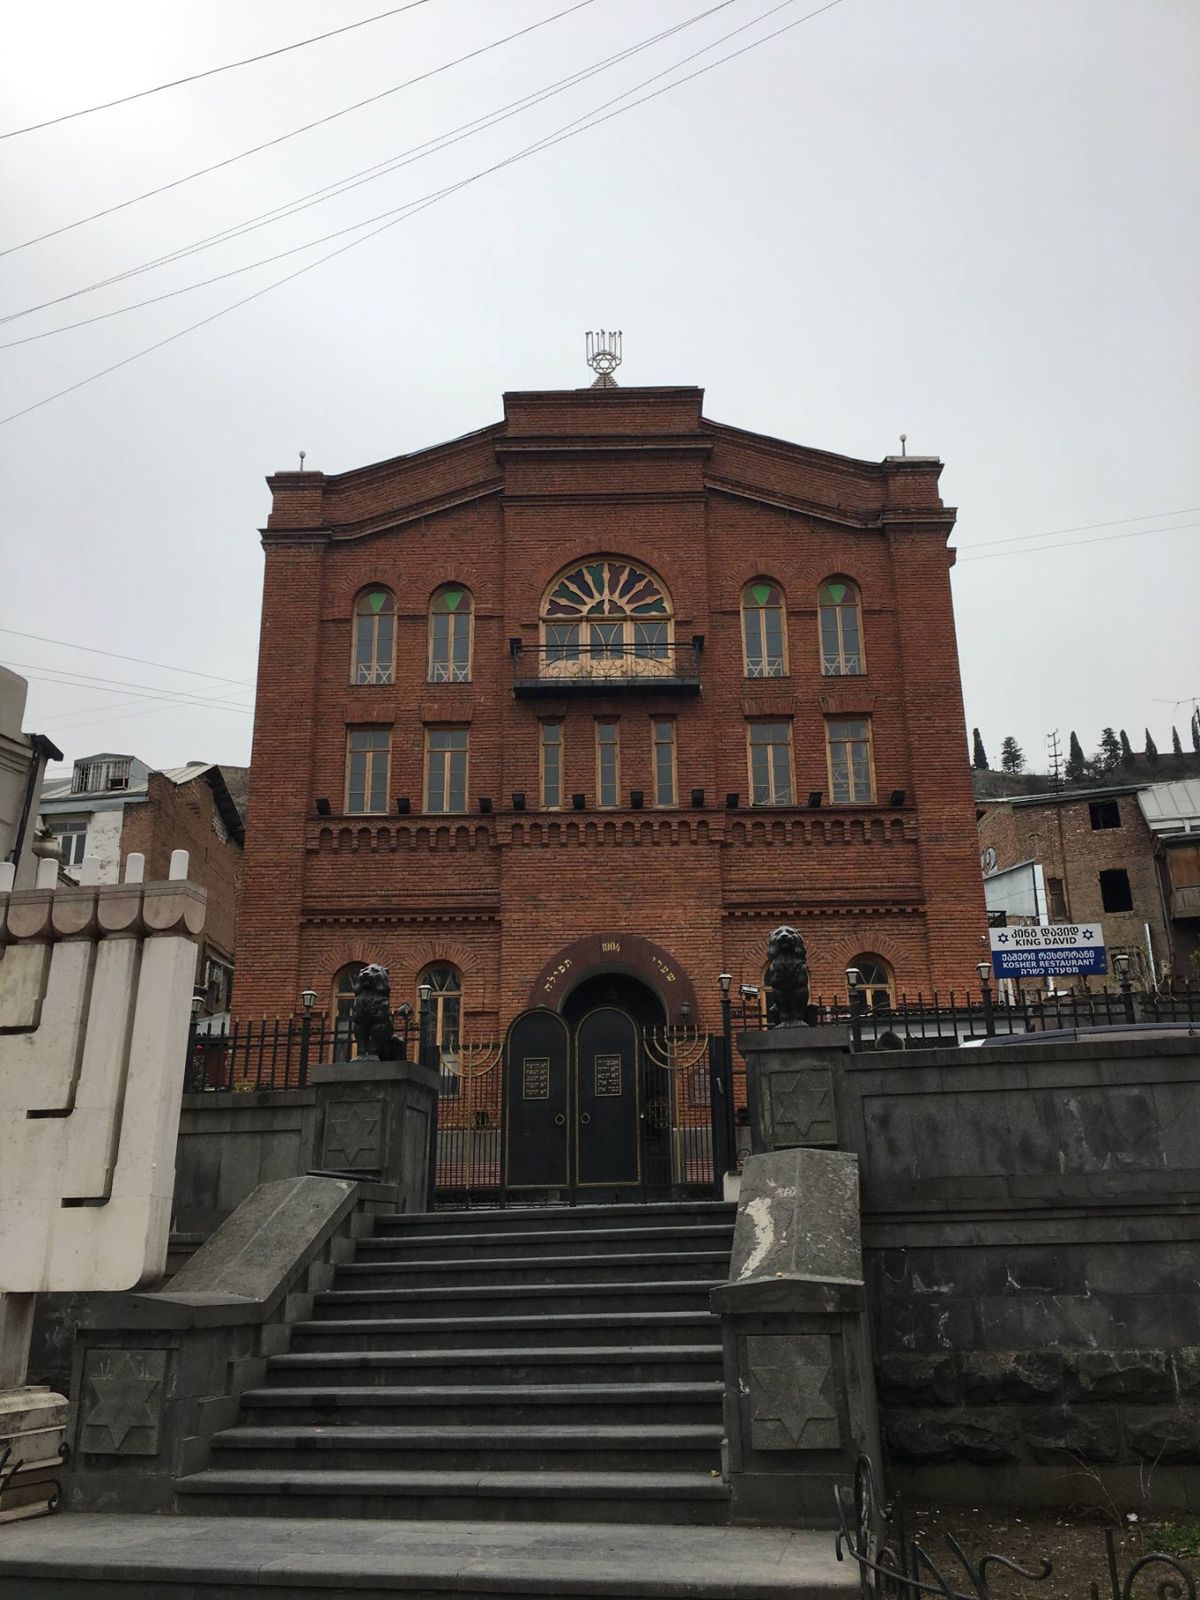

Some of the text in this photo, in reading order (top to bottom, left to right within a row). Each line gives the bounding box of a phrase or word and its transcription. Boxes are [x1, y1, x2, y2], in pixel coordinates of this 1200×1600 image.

[1011, 926, 1079, 939] კინგ დავიდ
[1015, 936, 1077, 946] KING DAVID
[602, 942, 620, 953] 1904
[652, 956, 676, 982] שערי
[1002, 959, 1094, 969] KOSHER RESTAURANT
